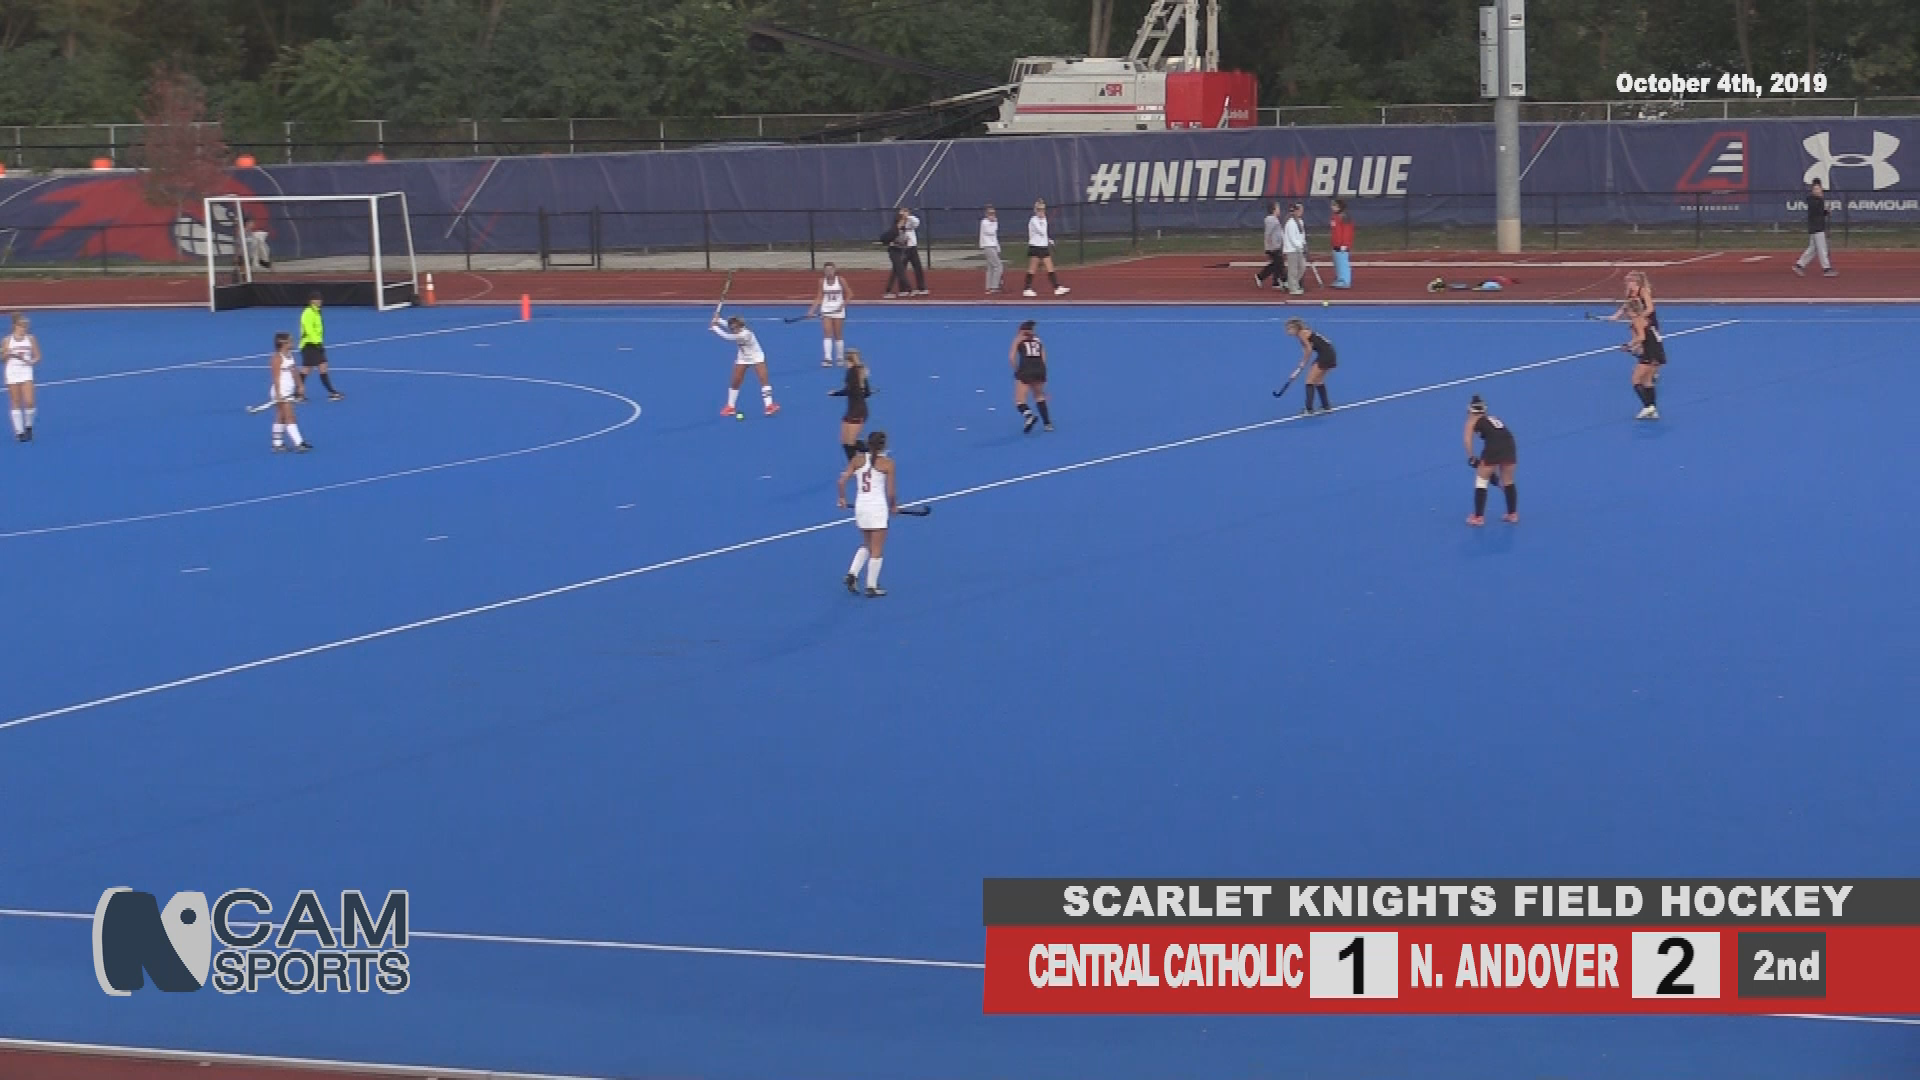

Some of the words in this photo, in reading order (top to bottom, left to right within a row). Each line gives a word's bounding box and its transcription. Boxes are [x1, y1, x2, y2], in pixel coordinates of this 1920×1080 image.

[1786, 200, 1842, 211] UNR
[1847, 199, 1919, 211] ARMOUR
[1023, 341, 1041, 357] 12
[861, 471, 872, 493] 5
